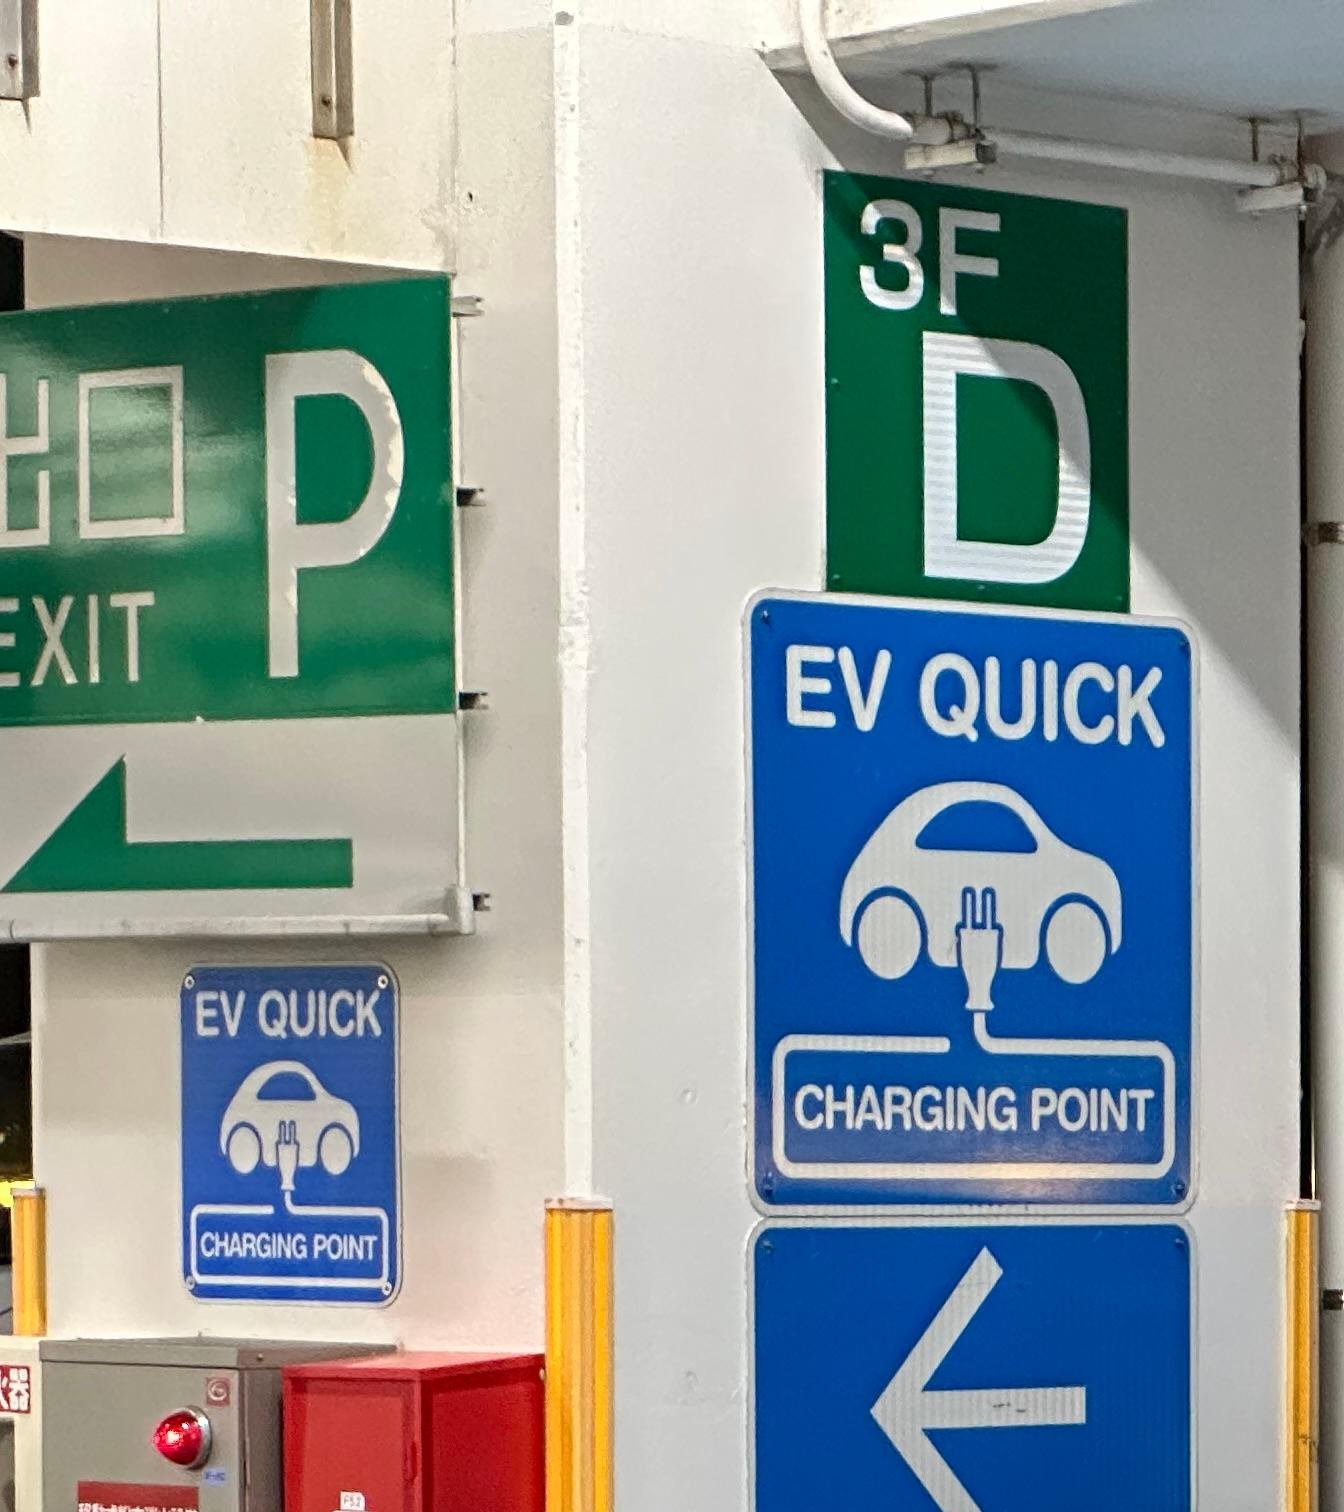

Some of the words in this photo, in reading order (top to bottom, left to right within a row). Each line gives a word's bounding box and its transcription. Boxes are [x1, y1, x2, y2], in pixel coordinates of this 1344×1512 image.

[859, 199, 1001, 315] 3F
[922, 330, 1092, 585] D
[265, 348, 406, 679] P
[785, 643, 892, 733] EV
[918, 651, 1166, 748] QUICK
[194, 989, 246, 1038] EV
[258, 988, 382, 1039] QUICK
[793, 1083, 1018, 1132] CHARGING
[1031, 1086, 1155, 1133] POINT
[200, 1230, 308, 1260] CHARGING
[313, 1233, 377, 1261] POINT
